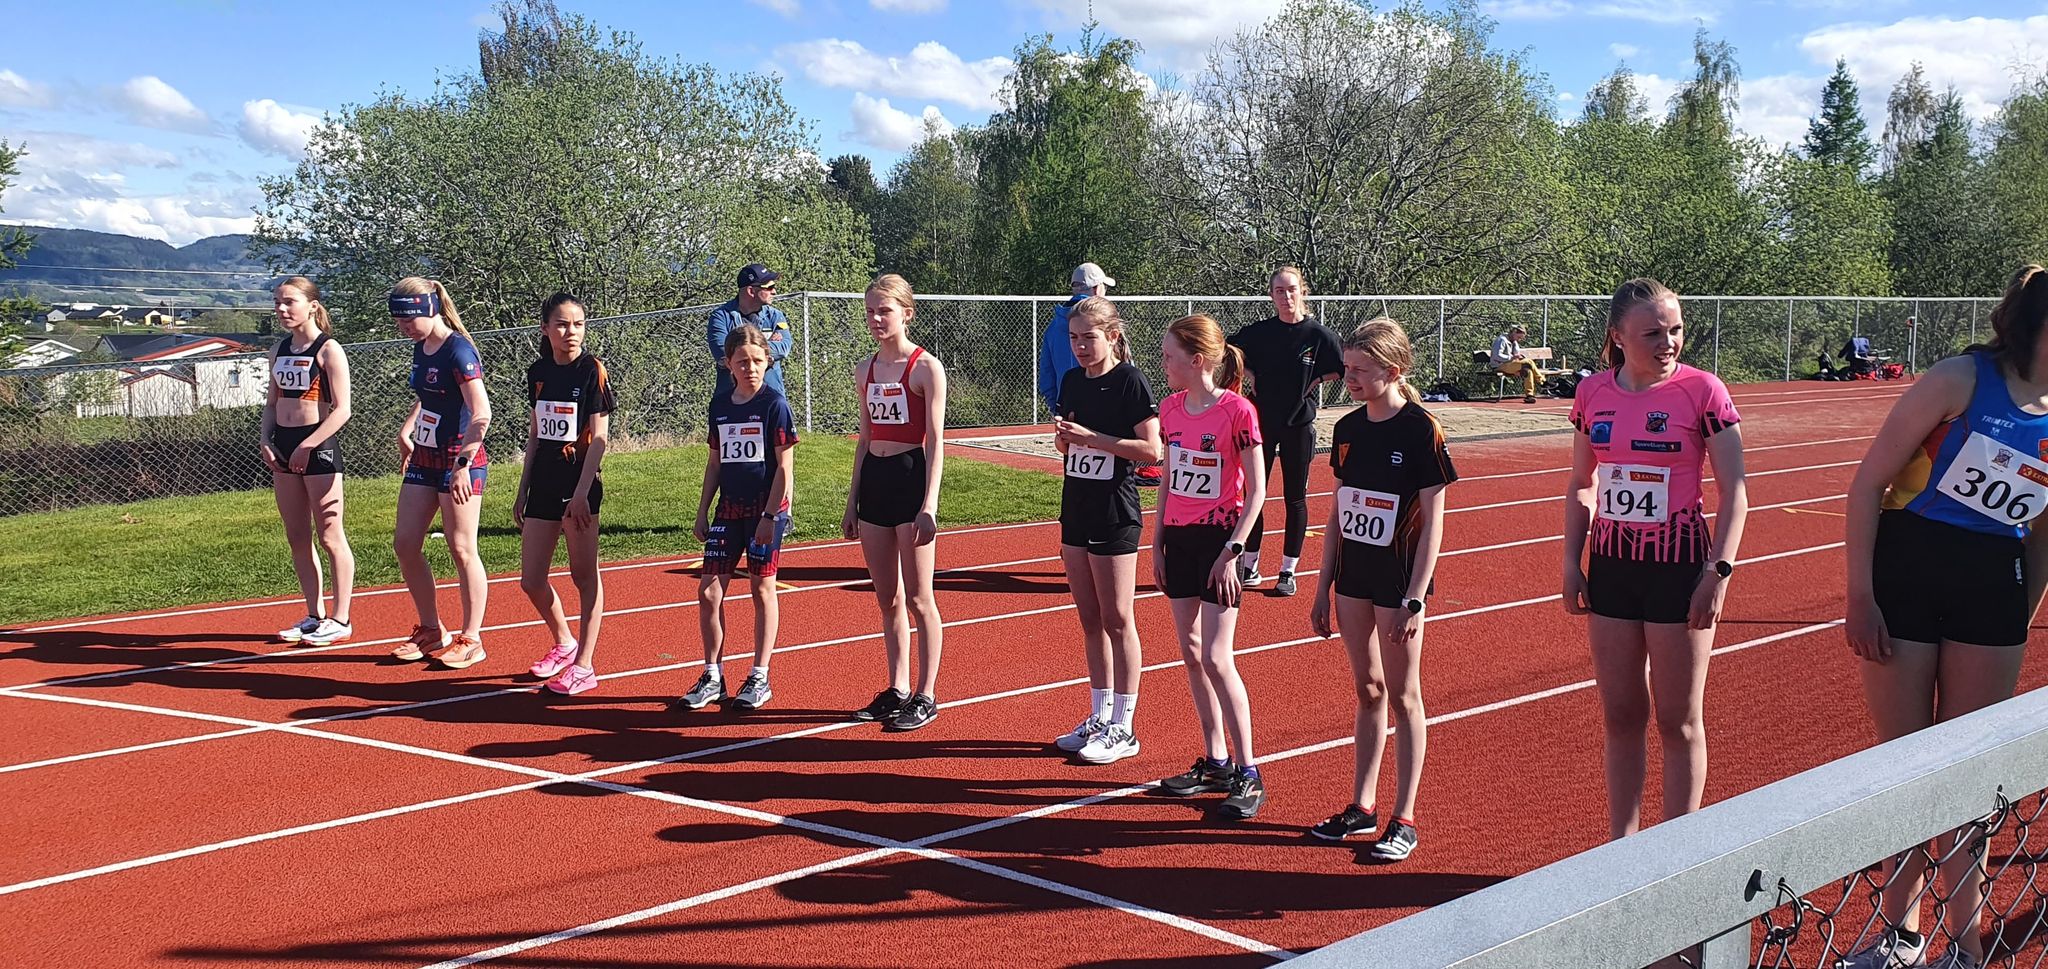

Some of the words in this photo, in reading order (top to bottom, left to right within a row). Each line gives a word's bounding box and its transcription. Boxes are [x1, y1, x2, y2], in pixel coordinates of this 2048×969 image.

[276, 371, 304, 387] 291
[869, 402, 902, 421] 224
[540, 418, 570, 438] 309
[721, 440, 757, 460] 130
[1069, 453, 1107, 476] 167
[1170, 468, 1212, 495] 172
[1603, 488, 1658, 517] 194
[1953, 466, 2036, 521] 306
[1342, 510, 1385, 541] 280
